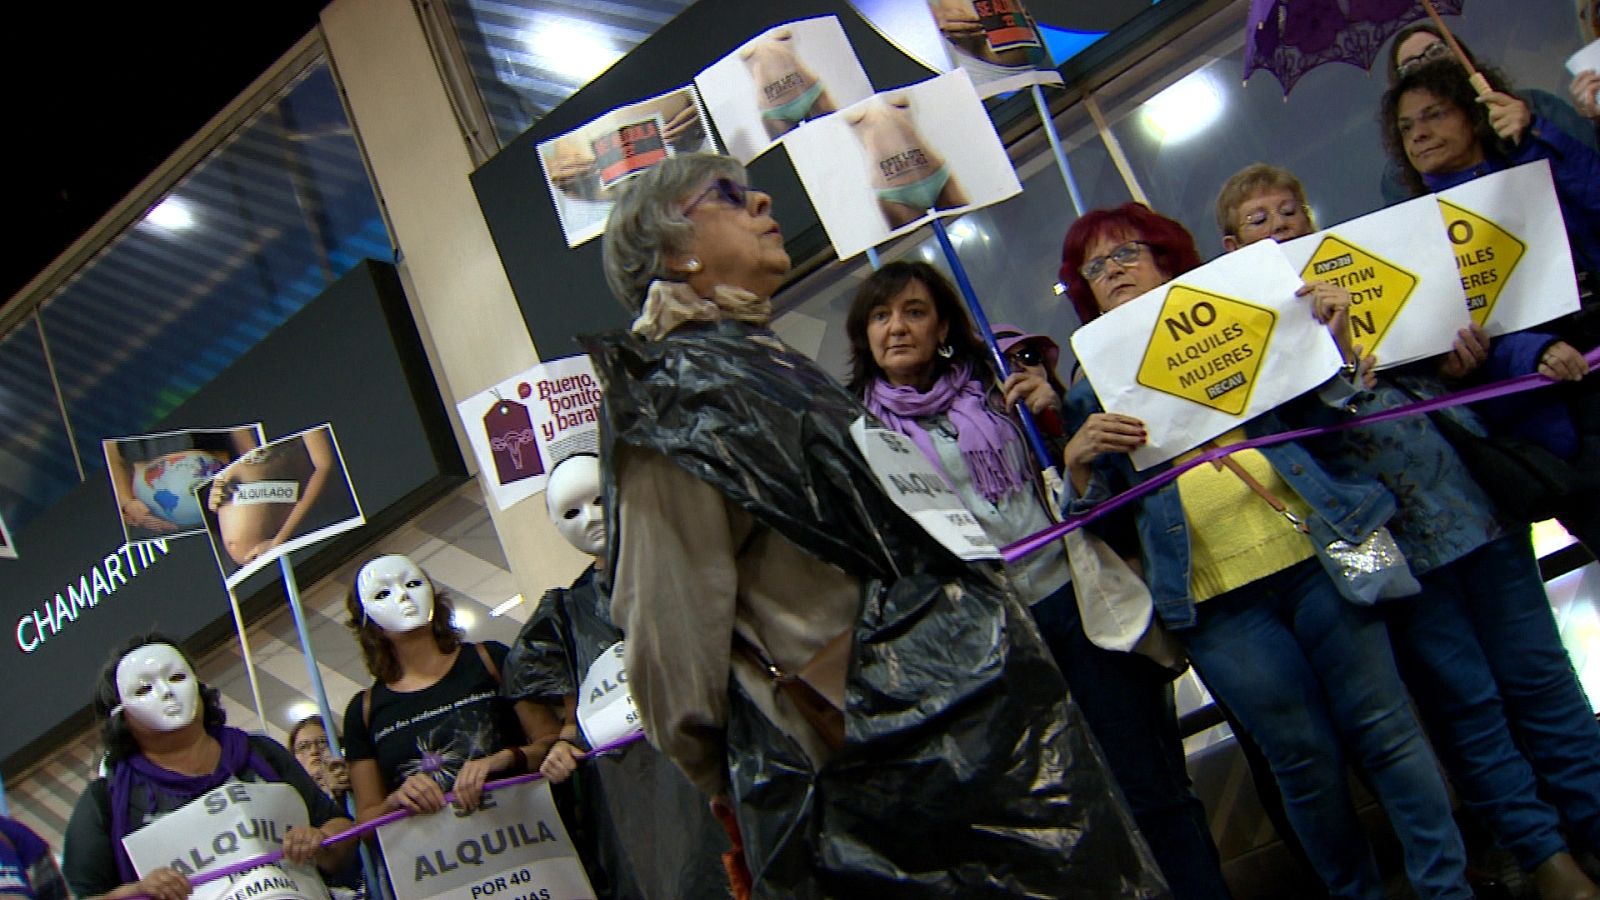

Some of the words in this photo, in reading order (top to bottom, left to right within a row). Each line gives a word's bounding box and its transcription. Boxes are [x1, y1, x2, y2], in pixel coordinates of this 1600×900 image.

[1447, 219, 1474, 245] O
[1460, 268, 1498, 290] ERES
[1164, 301, 1217, 342] NO
[1166, 322, 1244, 371] ALQUILES
[1178, 343, 1254, 389] MUJERES
[538, 373, 596, 400] Bueno,
[1207, 372, 1244, 398] RECAV
[549, 389, 602, 414] bonito
[542, 421, 555, 441] y
[204, 784, 250, 815] SE
[414, 820, 557, 882] ALQUILA
[225, 876, 299, 900] EMANAS
[471, 877, 508, 900] POR
[510, 868, 532, 884] 40
